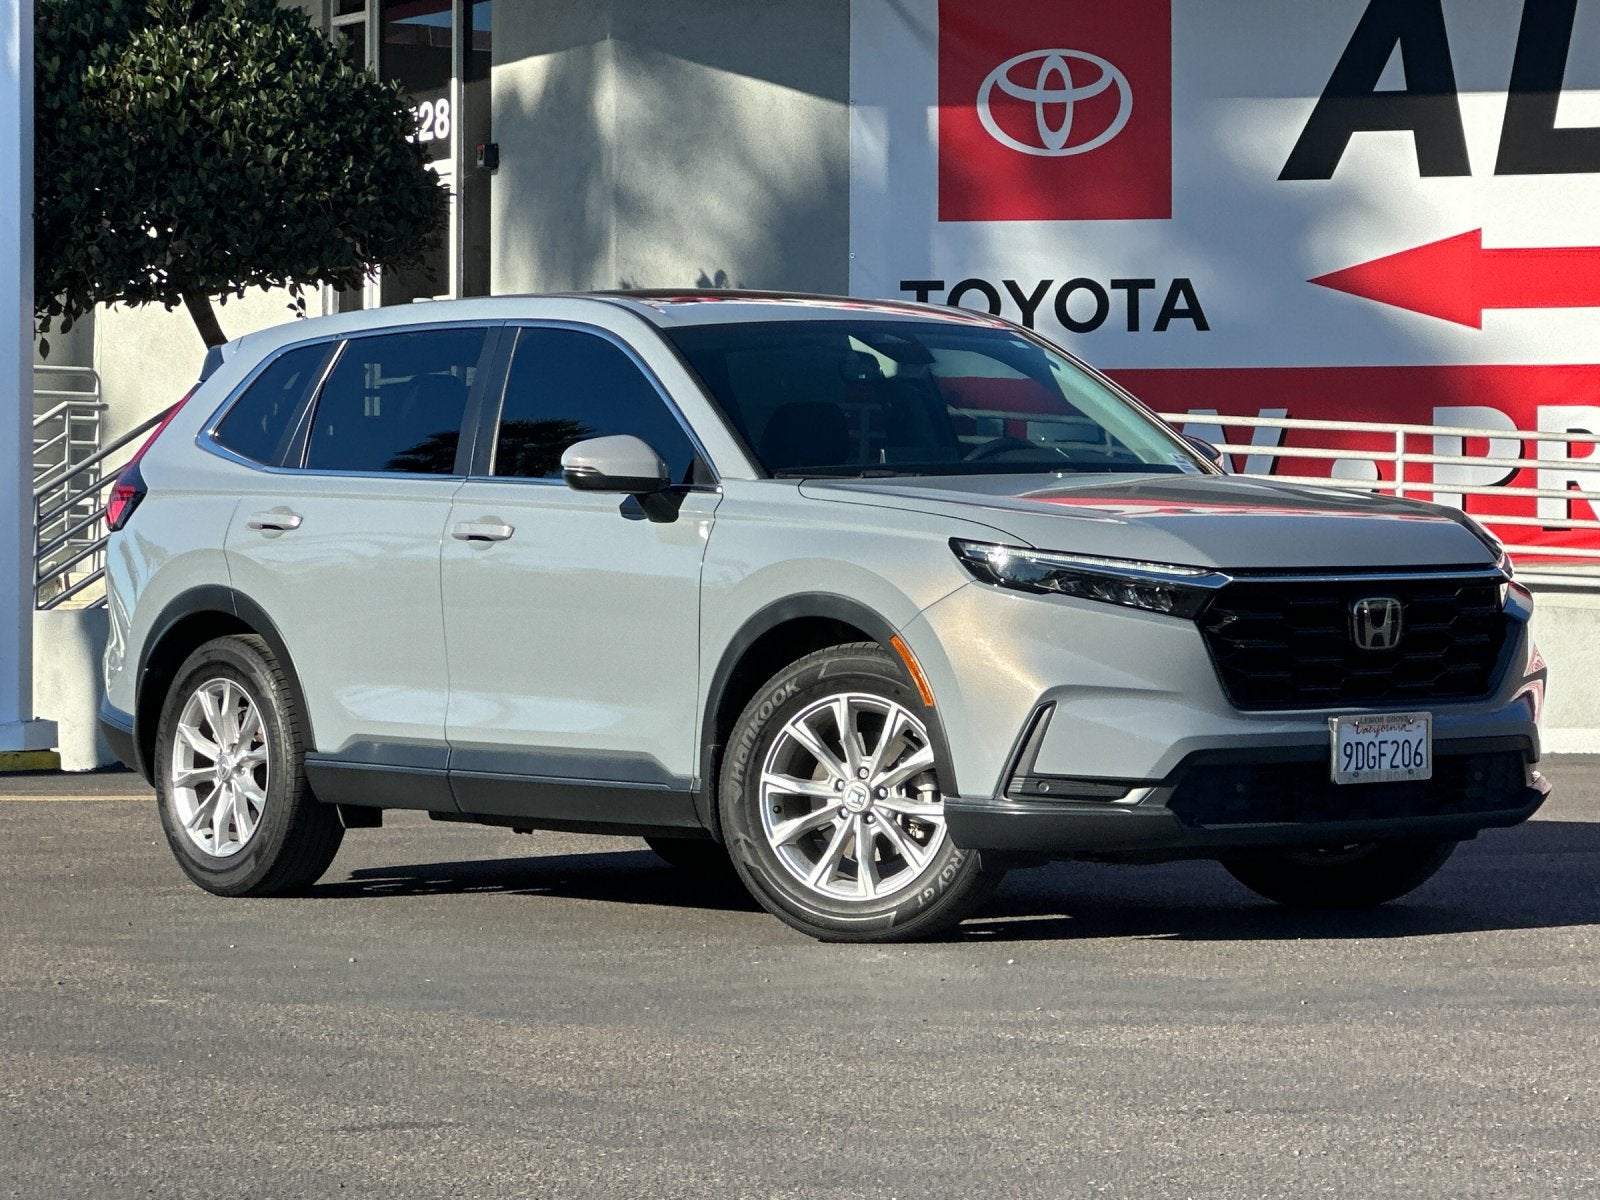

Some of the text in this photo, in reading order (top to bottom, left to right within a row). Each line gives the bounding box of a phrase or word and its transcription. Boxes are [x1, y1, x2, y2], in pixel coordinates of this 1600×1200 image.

[1355, 723, 1412, 738] California
[1343, 738, 1424, 771] 9DGF206
[917, 849, 966, 909] RGY GT
